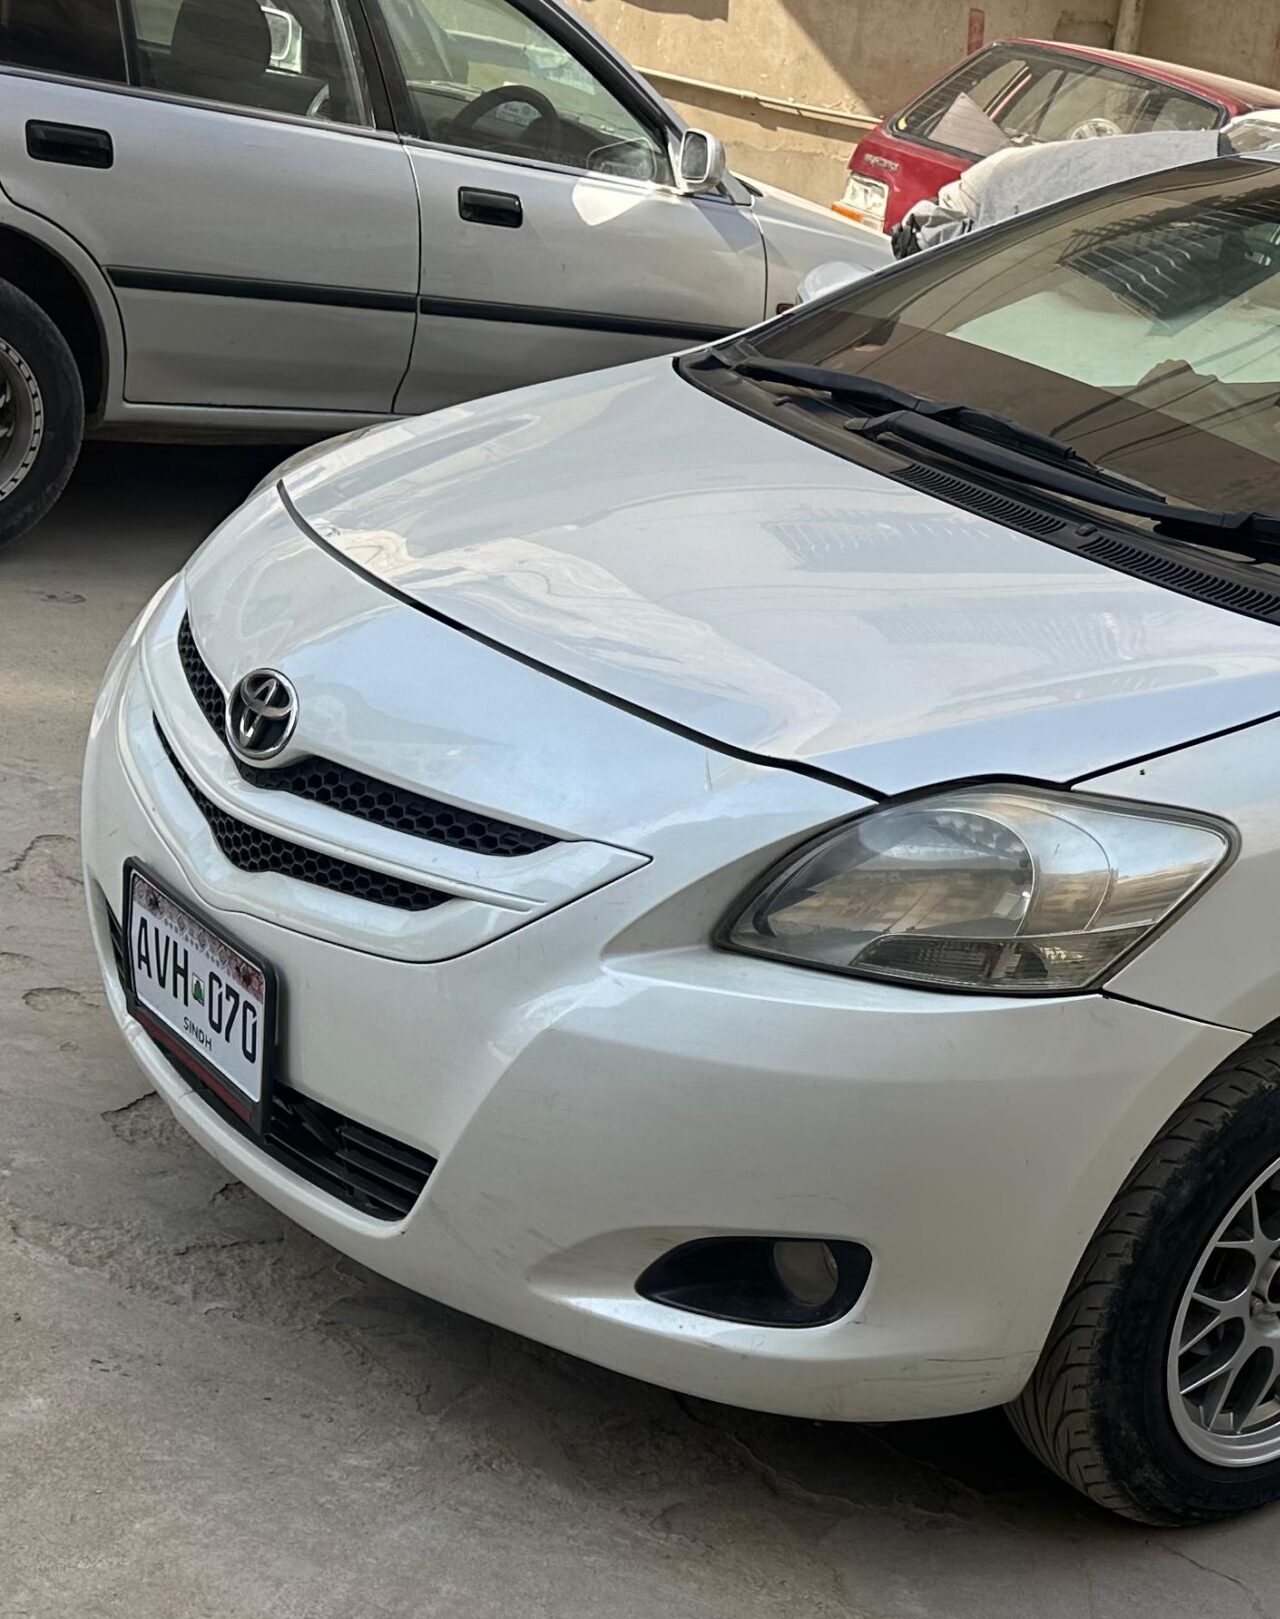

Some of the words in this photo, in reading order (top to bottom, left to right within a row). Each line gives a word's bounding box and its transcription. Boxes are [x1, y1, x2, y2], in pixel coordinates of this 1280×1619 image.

[138, 917, 188, 1007] AVH
[208, 971, 257, 1064] 070
[183, 1016, 212, 1050] SINDH
